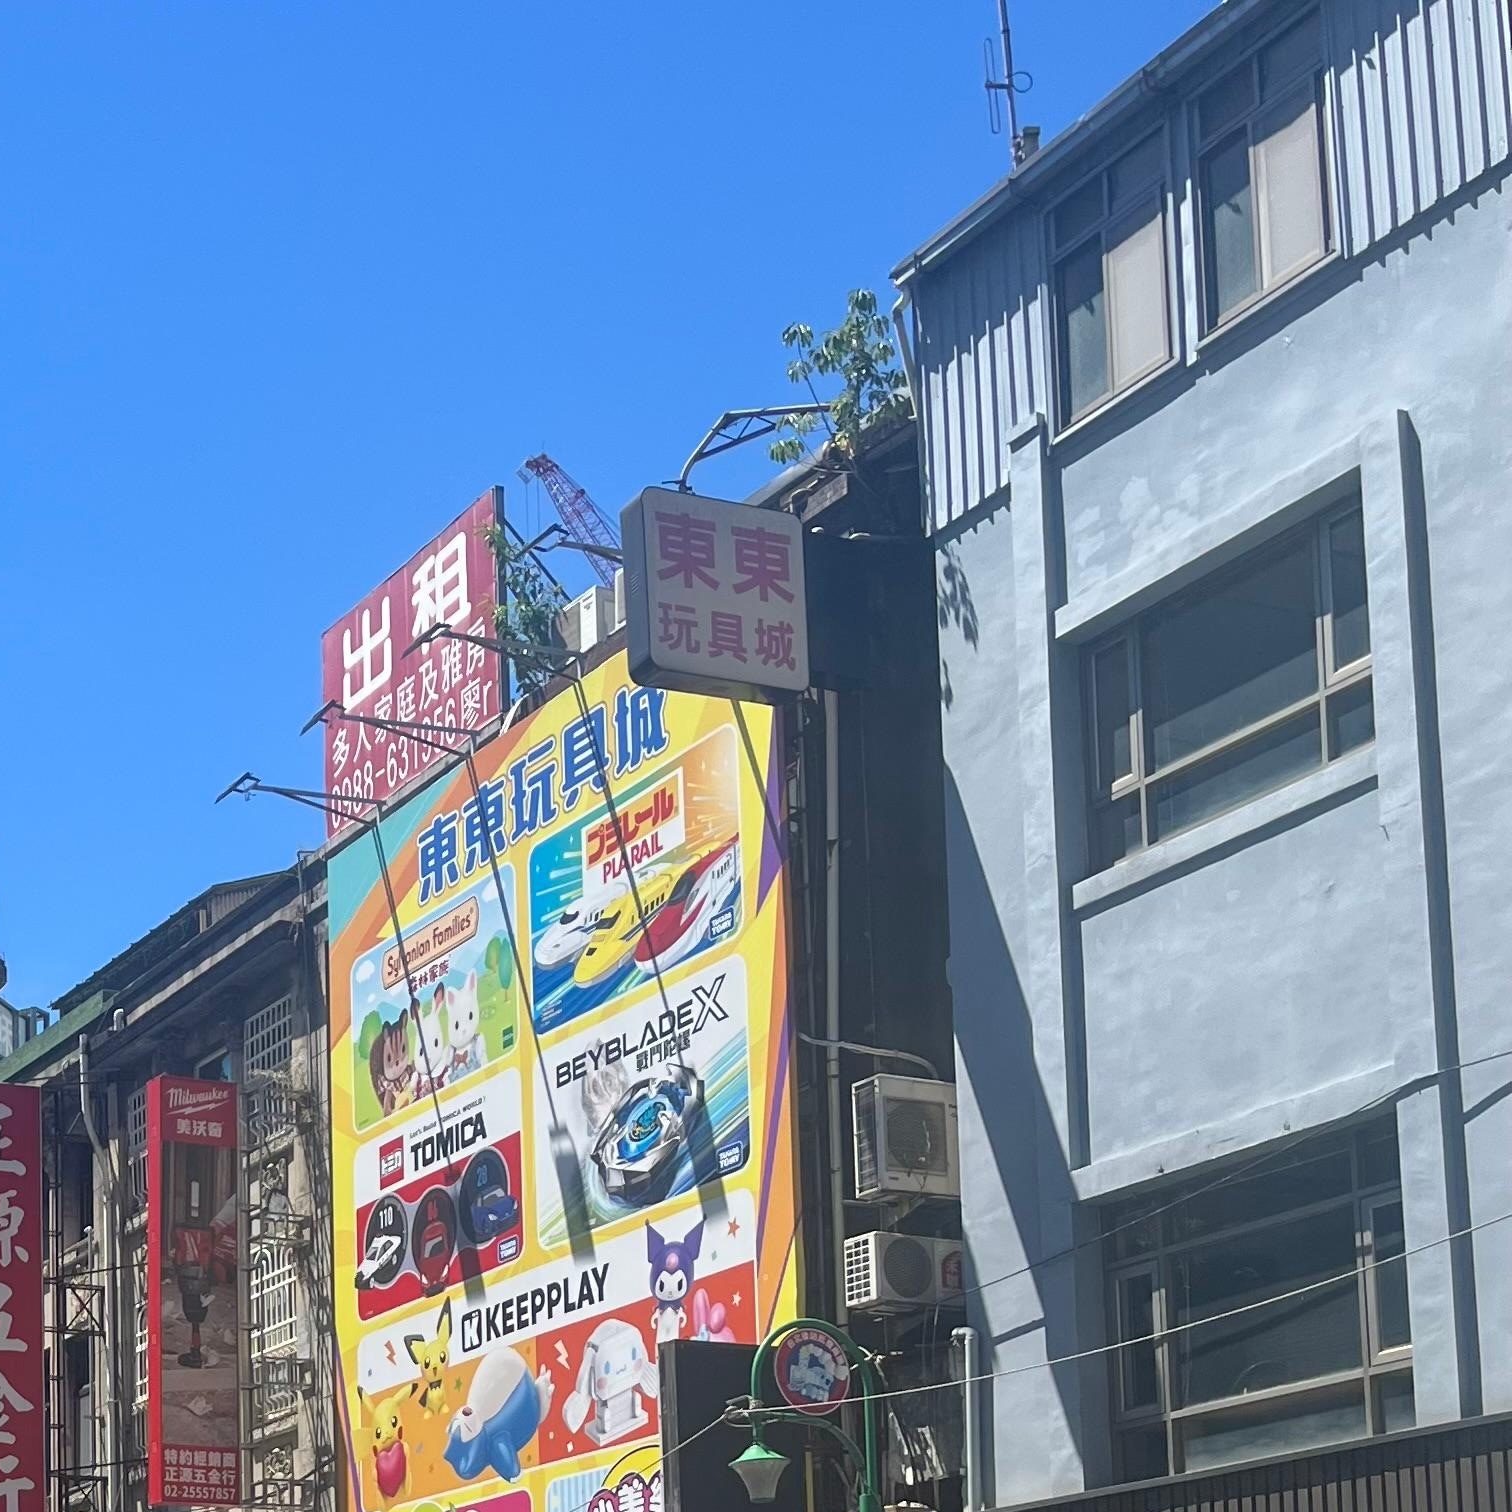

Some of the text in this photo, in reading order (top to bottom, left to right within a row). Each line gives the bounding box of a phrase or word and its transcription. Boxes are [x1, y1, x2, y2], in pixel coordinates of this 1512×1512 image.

[655, 511, 794, 602] 東東
[342, 532, 473, 712] 出租
[658, 602, 797, 671] 玩具城
[416, 682, 669, 906] 東東玩具城
[432, 914, 472, 948] Families
[556, 999, 694, 1089] BEYBLADE
[166, 1087, 230, 1109] Milwaukee
[411, 1112, 488, 1171] TOMICA
[486, 1262, 609, 1342] KEEPPLAY
[164, 1466, 236, 1486] 正源五金行
